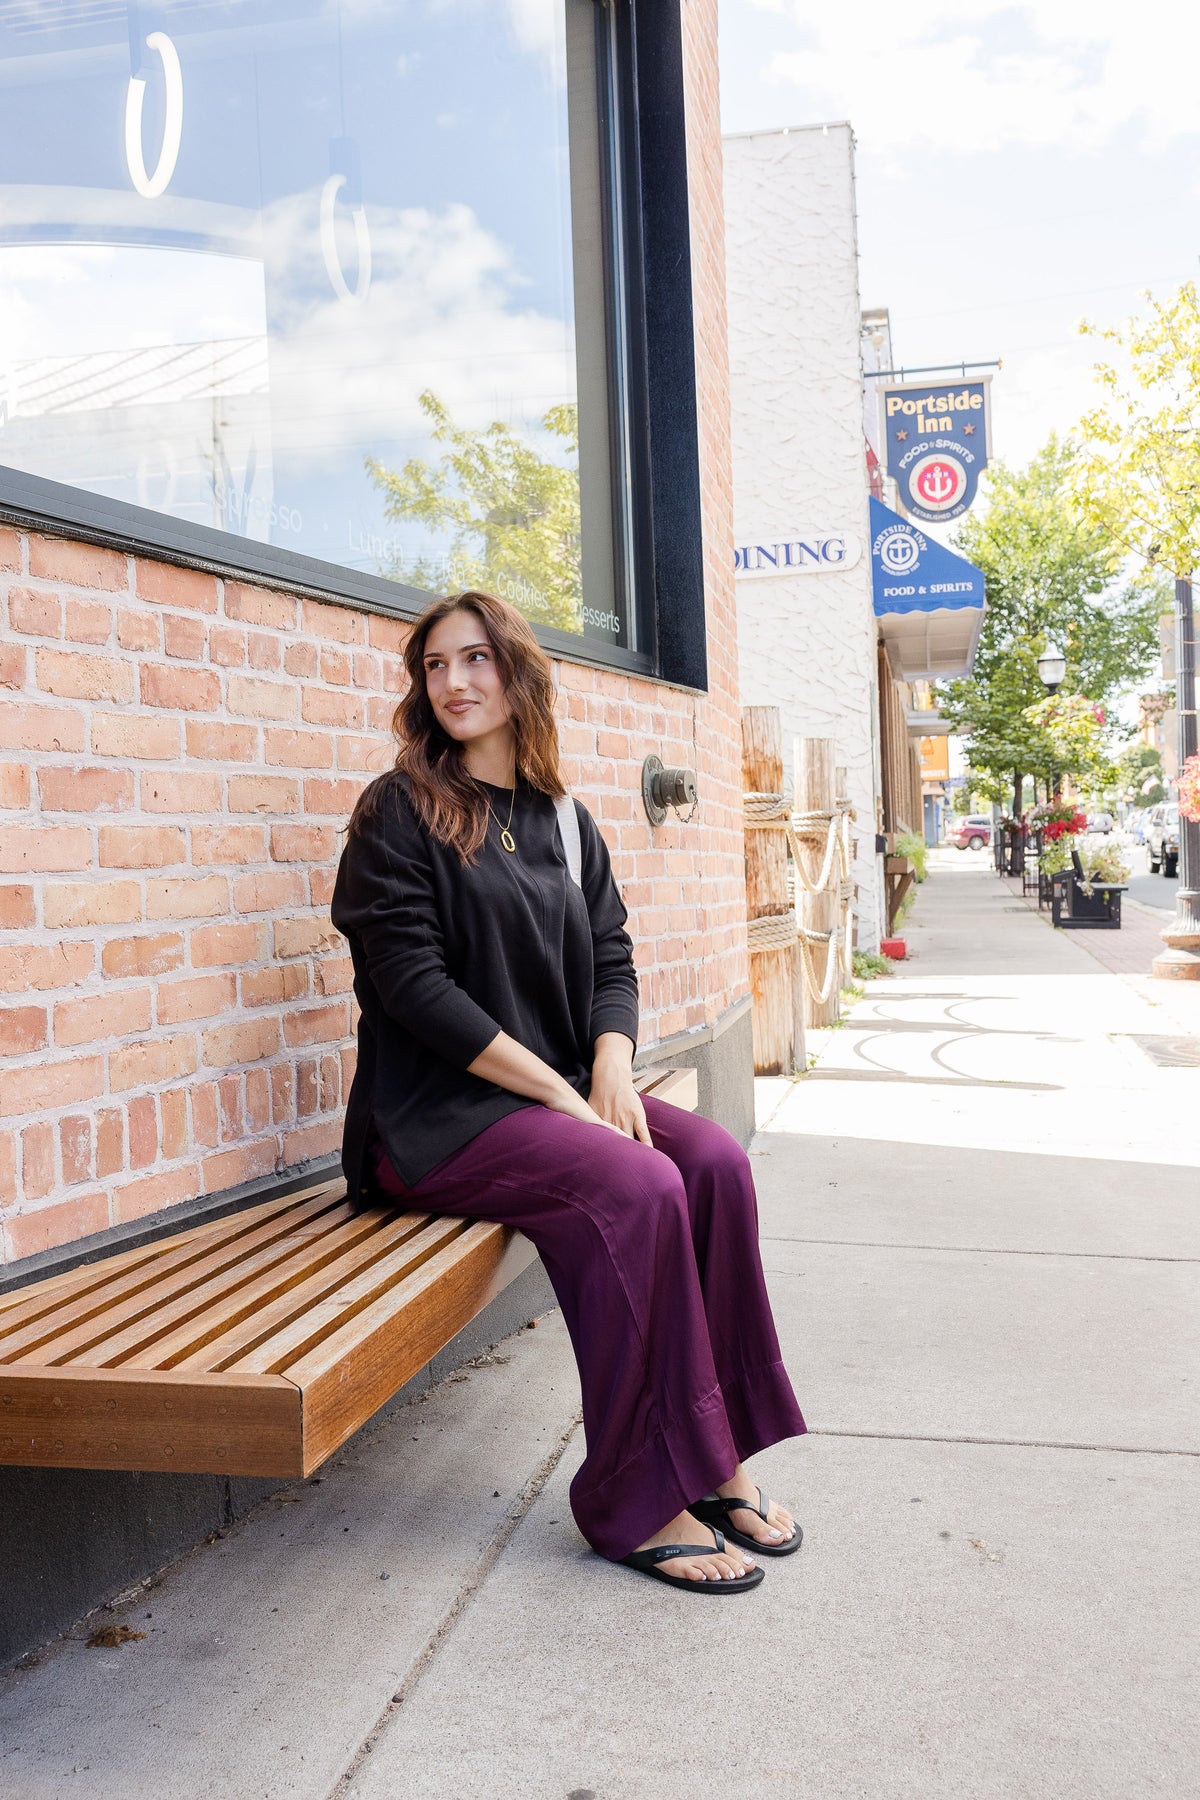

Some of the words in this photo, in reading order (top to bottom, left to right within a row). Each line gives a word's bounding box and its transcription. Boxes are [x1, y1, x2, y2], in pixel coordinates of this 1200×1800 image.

[886, 389, 984, 417] Portside
[916, 413, 953, 434] Inn
[898, 441, 930, 469] FOOD
[934, 438, 975, 464] SPIRITS
[348, 519, 404, 564] Lunch
[734, 538, 847, 571] INING
[872, 524, 913, 556] PORTSIDE
[913, 528, 928, 551] INN
[496, 571, 549, 610] Cookies
[883, 586, 916, 598] FOOD
[918, 586, 927, 594] &
[930, 582, 974, 593] SPIRITS
[574, 598, 621, 633] Desserts
